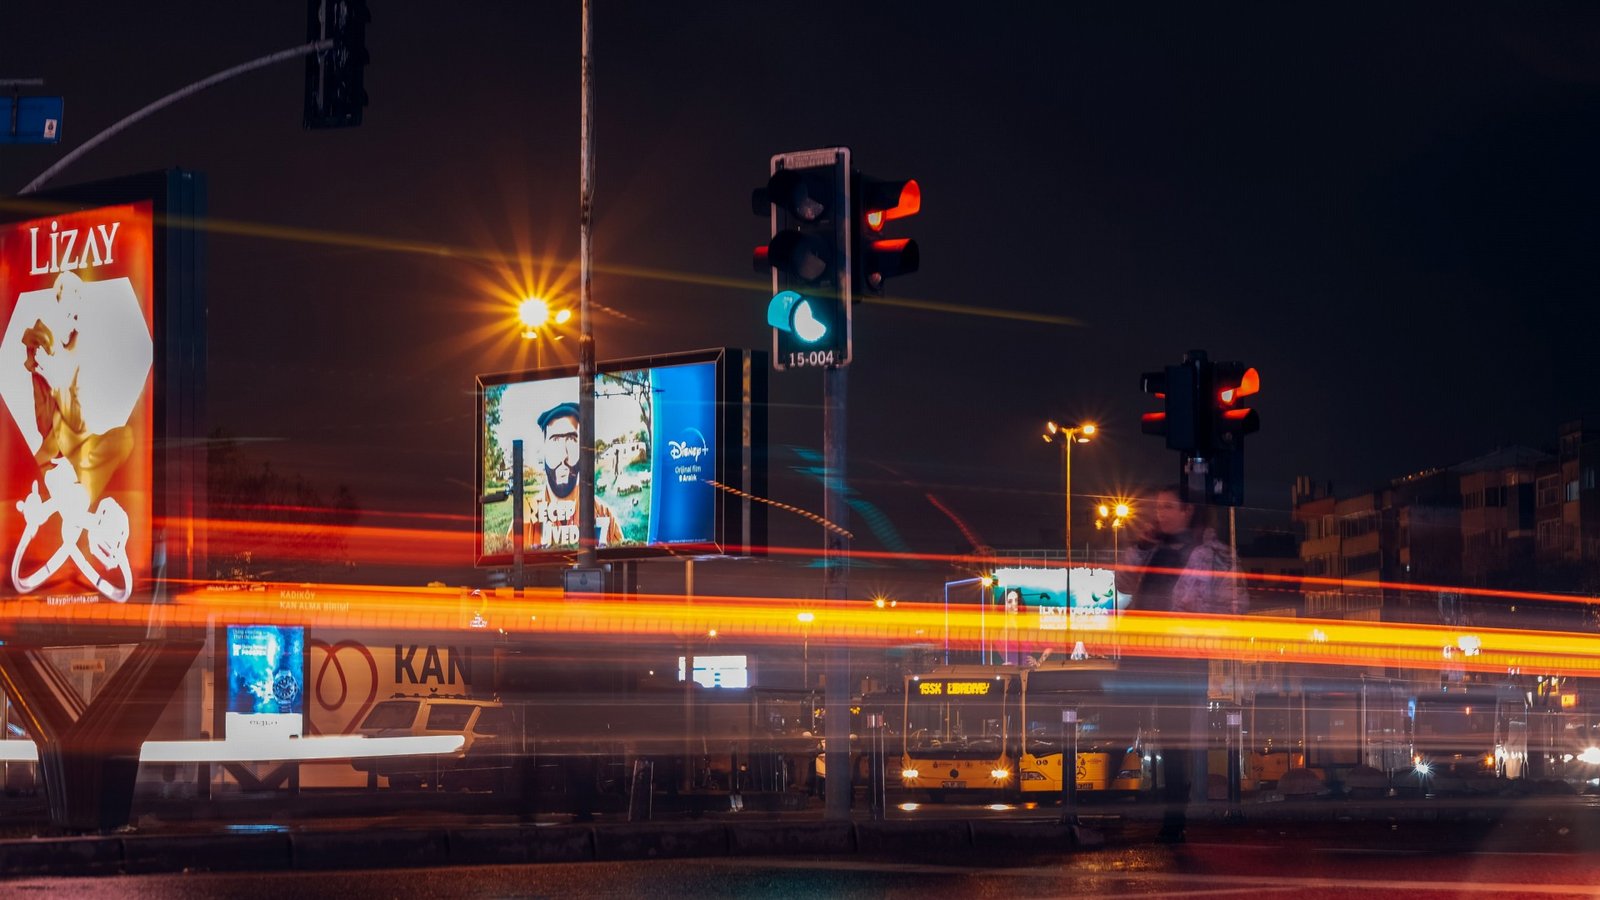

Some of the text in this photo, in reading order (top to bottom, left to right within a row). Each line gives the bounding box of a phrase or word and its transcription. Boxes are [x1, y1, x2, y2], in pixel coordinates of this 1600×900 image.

[789, 350, 834, 367] 15-004
[668, 441, 709, 462] Disney+
[280, 590, 316, 600] KADIKÖY
[279, 601, 297, 609] KAN
[299, 601, 322, 610] ALMA
[395, 644, 472, 686] KAN
